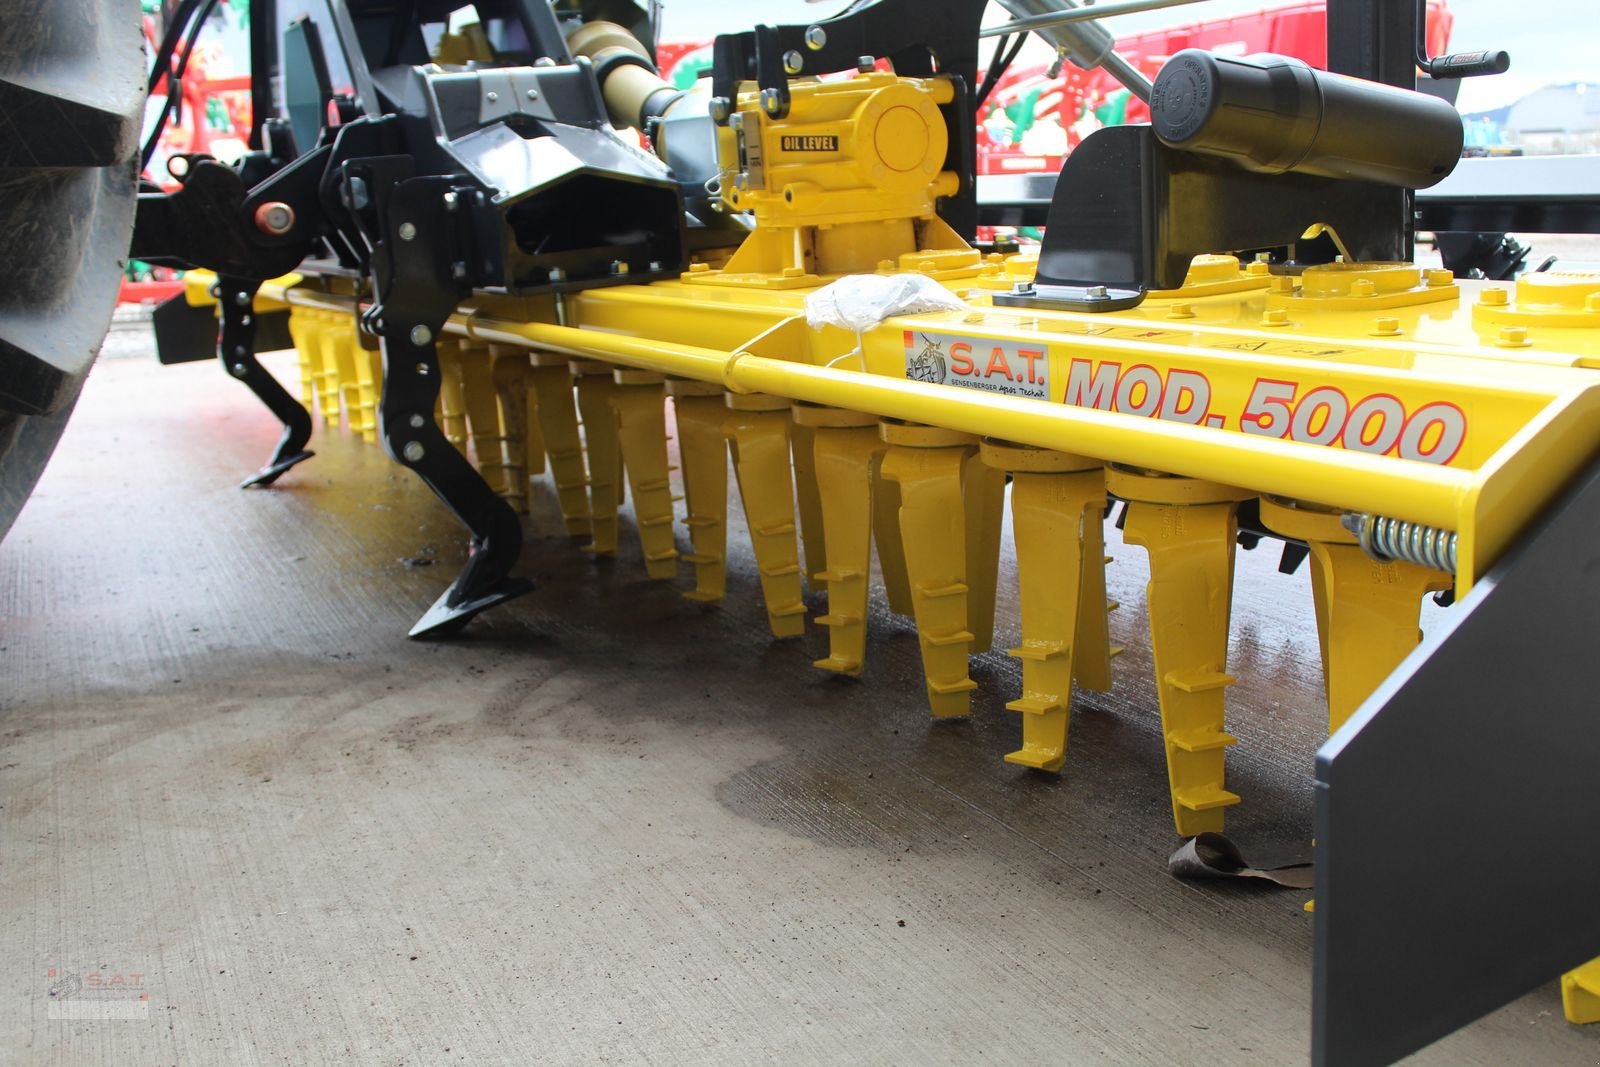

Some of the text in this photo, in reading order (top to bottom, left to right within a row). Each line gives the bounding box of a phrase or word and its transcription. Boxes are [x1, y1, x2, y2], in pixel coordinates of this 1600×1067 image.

[784, 136, 834, 150] OIL LEVEL
[950, 343, 1044, 385] S.A.T.
[952, 378, 997, 390] SENSENBERGER
[1019, 387, 1045, 397] Technik
[1064, 357, 1468, 467] MOD. 5000
